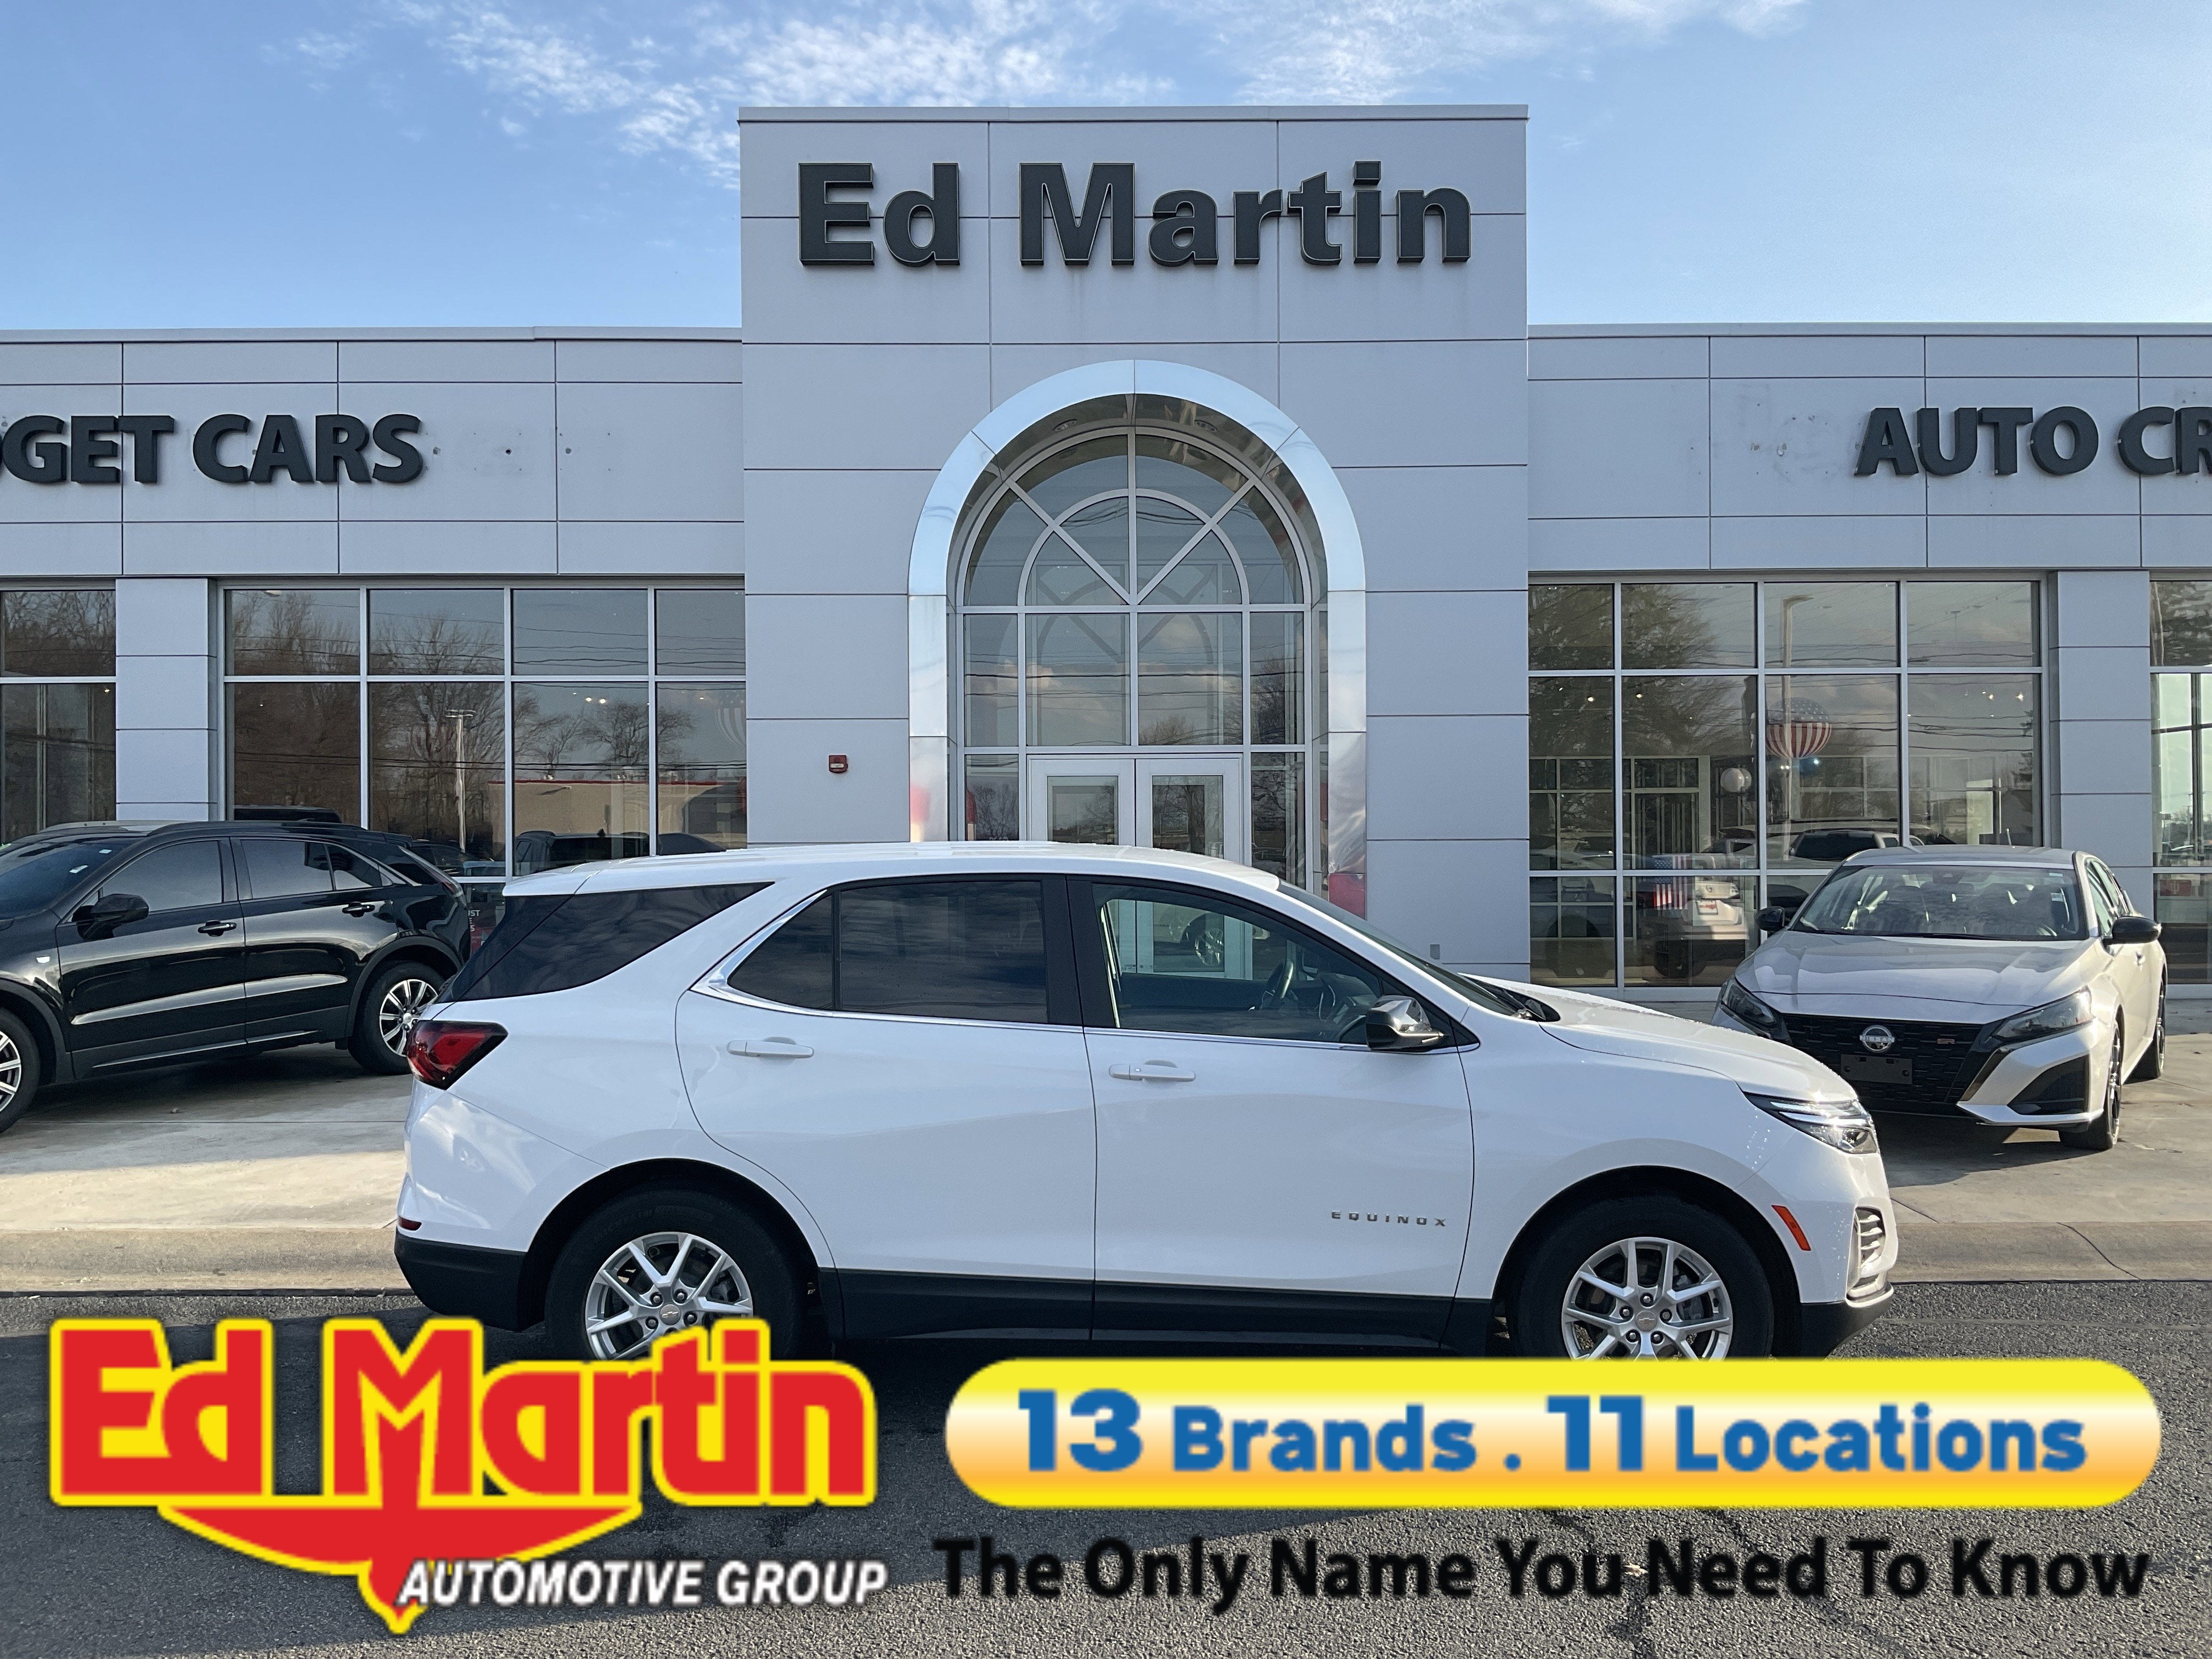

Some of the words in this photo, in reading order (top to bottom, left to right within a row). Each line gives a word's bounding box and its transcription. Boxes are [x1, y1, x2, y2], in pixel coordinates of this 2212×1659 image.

[798, 162, 960, 267] Ed
[1019, 160, 1472, 267] Martin
[0, 415, 175, 484] GET
[193, 414, 424, 484] CARS
[1854, 405, 2099, 476] AUTO
[1859, 1035, 1895, 1043] NISSAN
[1331, 1210, 1446, 1227] EQUINOX
